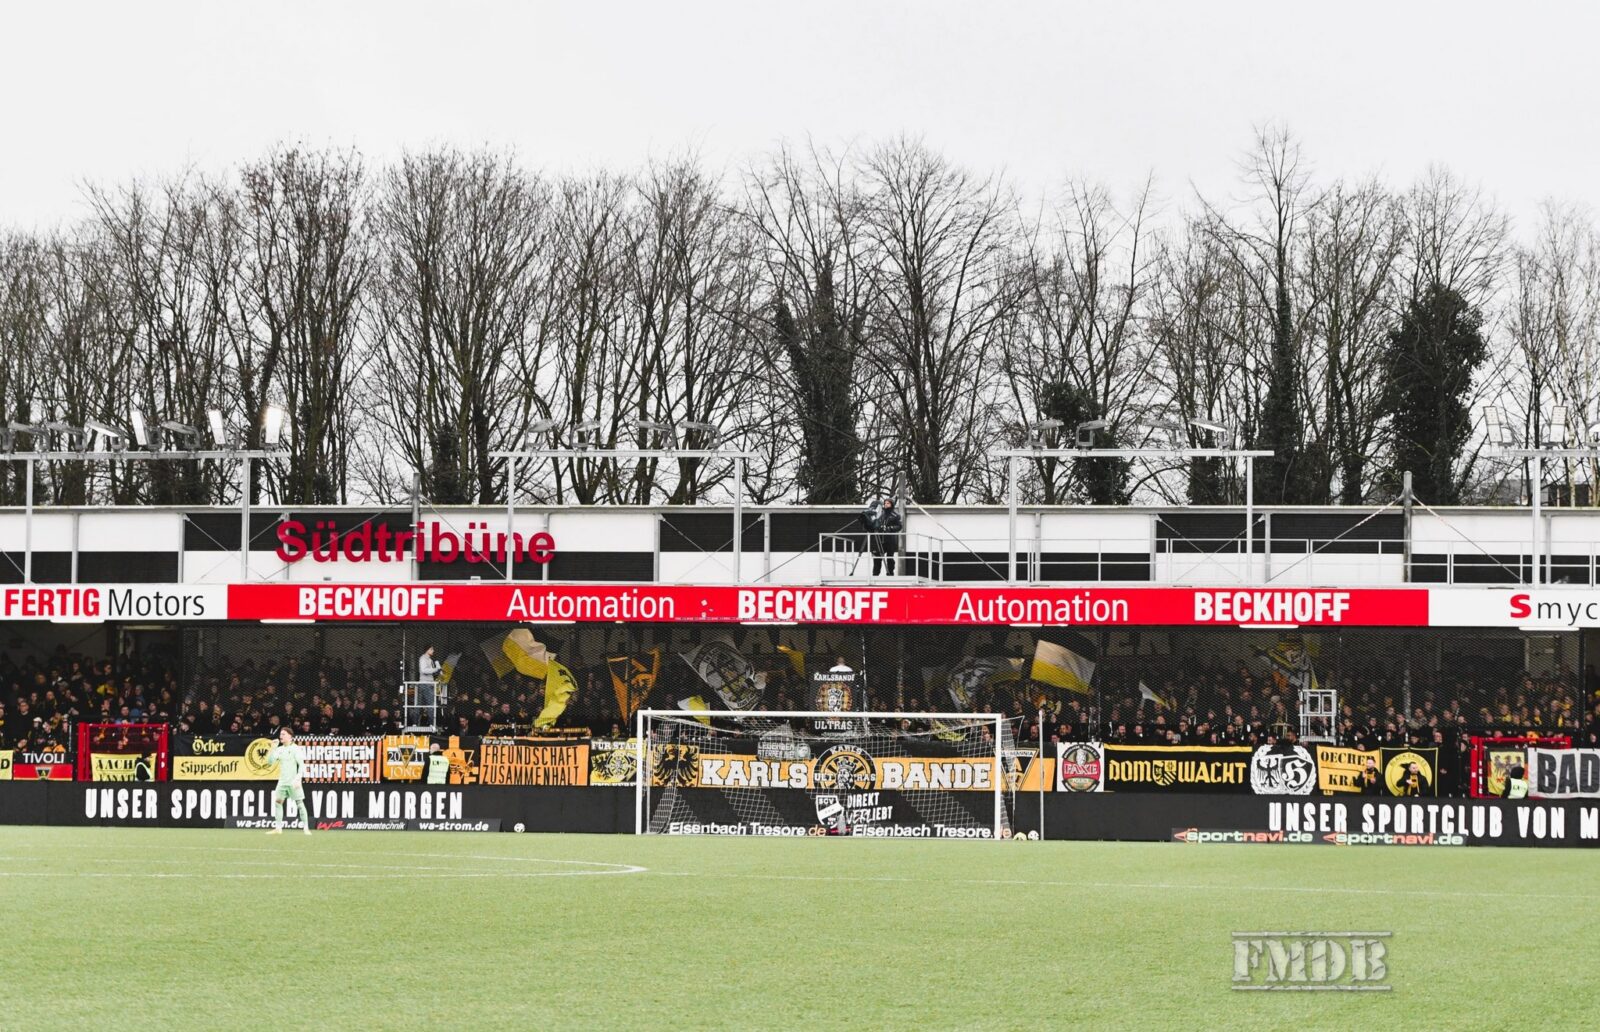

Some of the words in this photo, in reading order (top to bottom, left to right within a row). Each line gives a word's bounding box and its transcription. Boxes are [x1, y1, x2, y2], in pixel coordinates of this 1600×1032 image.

[275, 520, 555, 563] Südtribüne
[4, 589, 100, 616] FERTIG
[108, 588, 205, 616] Motors
[299, 587, 443, 616] BECKHOFF
[507, 589, 674, 618] Automation
[738, 590, 888, 620] BECKHOFF
[954, 592, 1128, 622] Automation
[1193, 591, 1350, 622] BECKHOFF
[814, 720, 853, 730] ULTRAS
[23, 752, 65, 764] TIVOLI
[485, 746, 578, 766] FREUNDSCHAFT
[482, 765, 579, 786] ZUSAMMENHALT
[701, 759, 808, 788] KARLS
[881, 762, 992, 789] BANDE
[1109, 760, 1152, 781] DOM
[1178, 761, 1247, 784] WACHT
[1537, 752, 1600, 793] BAD
[85, 788, 158, 818] UNSER
[312, 791, 354, 819] VON
[368, 791, 463, 820] MORGEN
[847, 792, 880, 808] DIREKT
[419, 821, 489, 831] wa-strom.de
[669, 822, 746, 836] Eisenbach
[750, 823, 827, 837] Tresore.de
[852, 823, 935, 838] Eisenbach
[936, 823, 1013, 839] Tresore.e
[1269, 802, 1348, 832] UNSER
[1362, 803, 1502, 838] SPORTCLUB
[1517, 806, 1565, 839] VON
[1186, 829, 1314, 844] sportnavi.de
